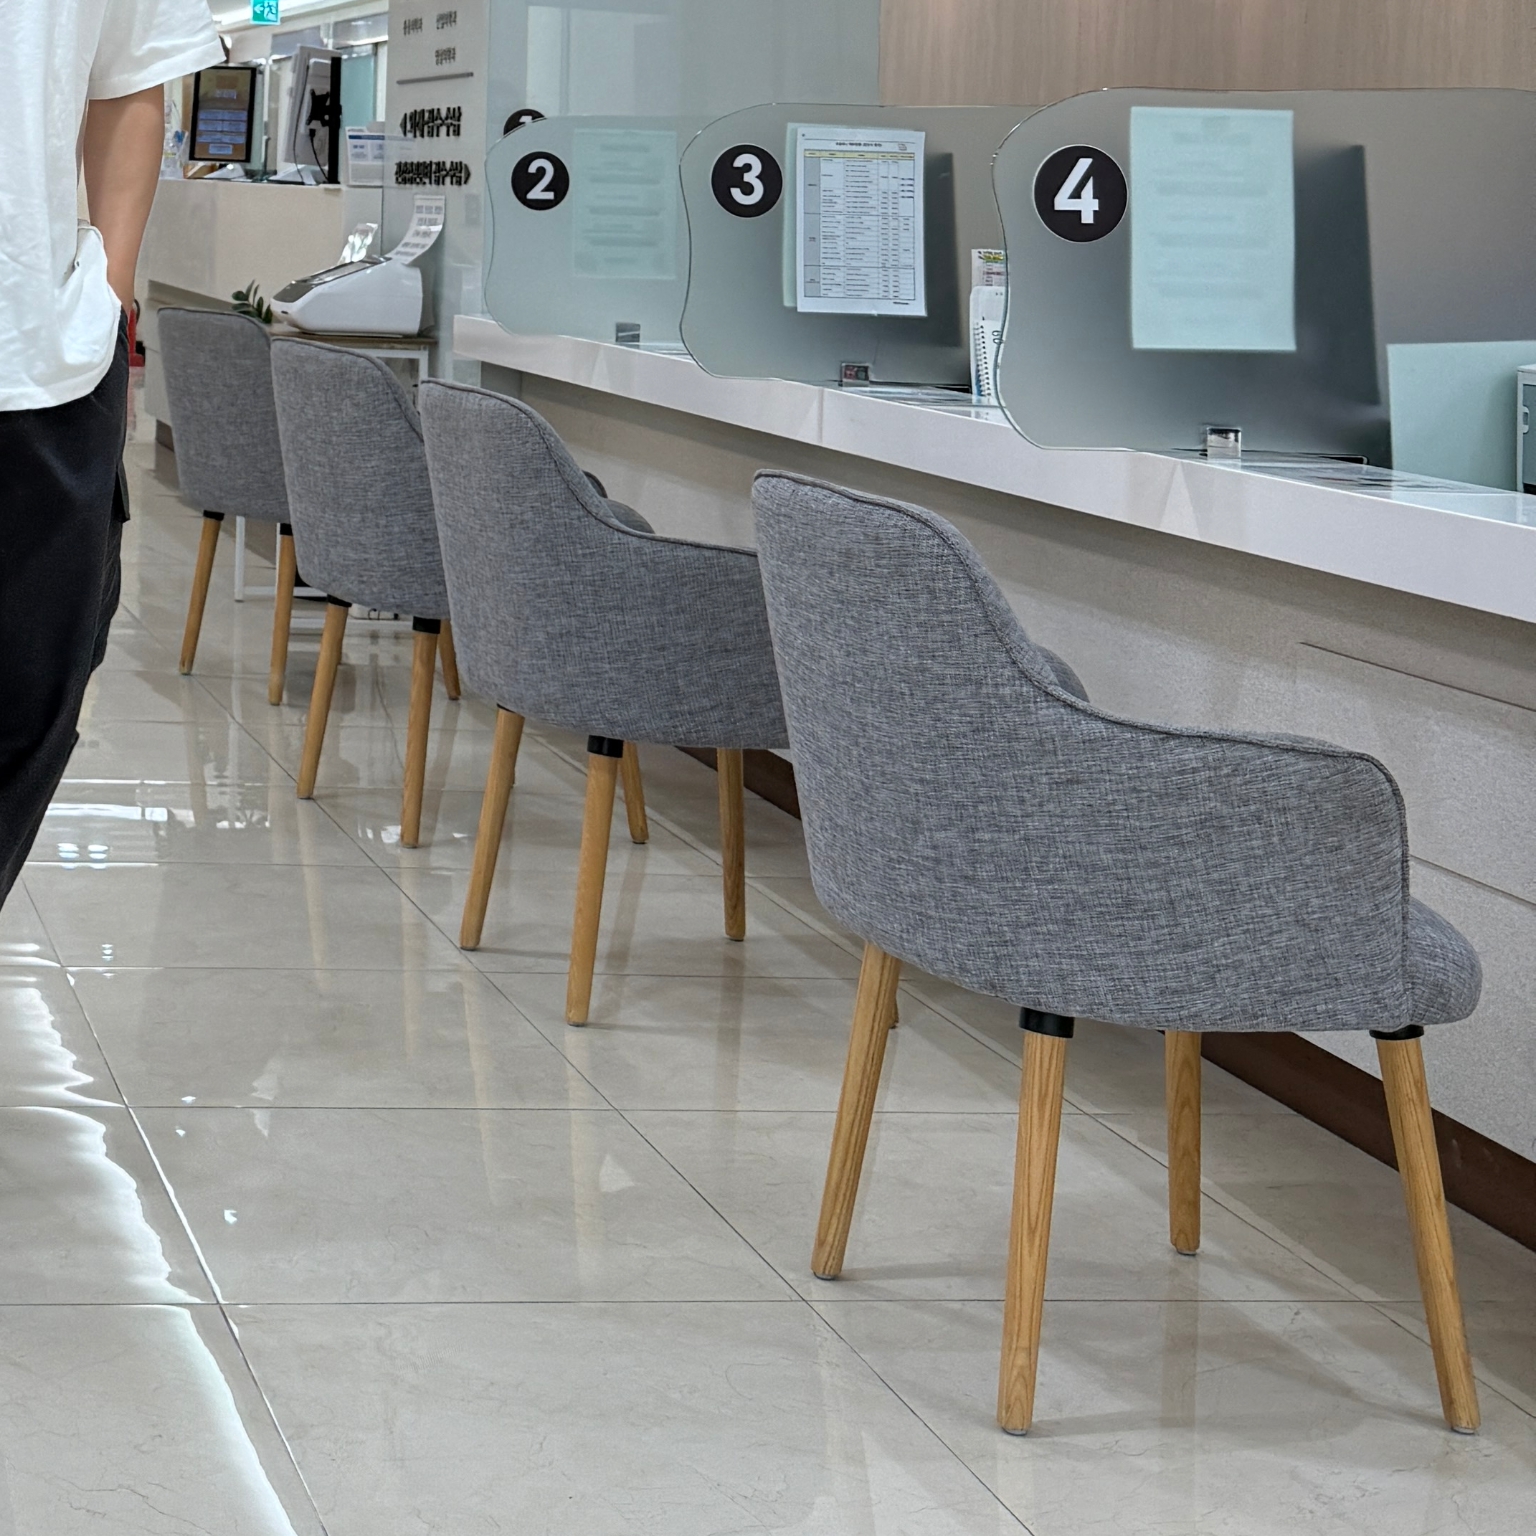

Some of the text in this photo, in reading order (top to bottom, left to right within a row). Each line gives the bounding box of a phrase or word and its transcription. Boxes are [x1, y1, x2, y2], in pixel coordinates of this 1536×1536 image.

[526, 158, 555, 200] 2
[729, 153, 765, 205] 3
[1054, 157, 1099, 224] 4
